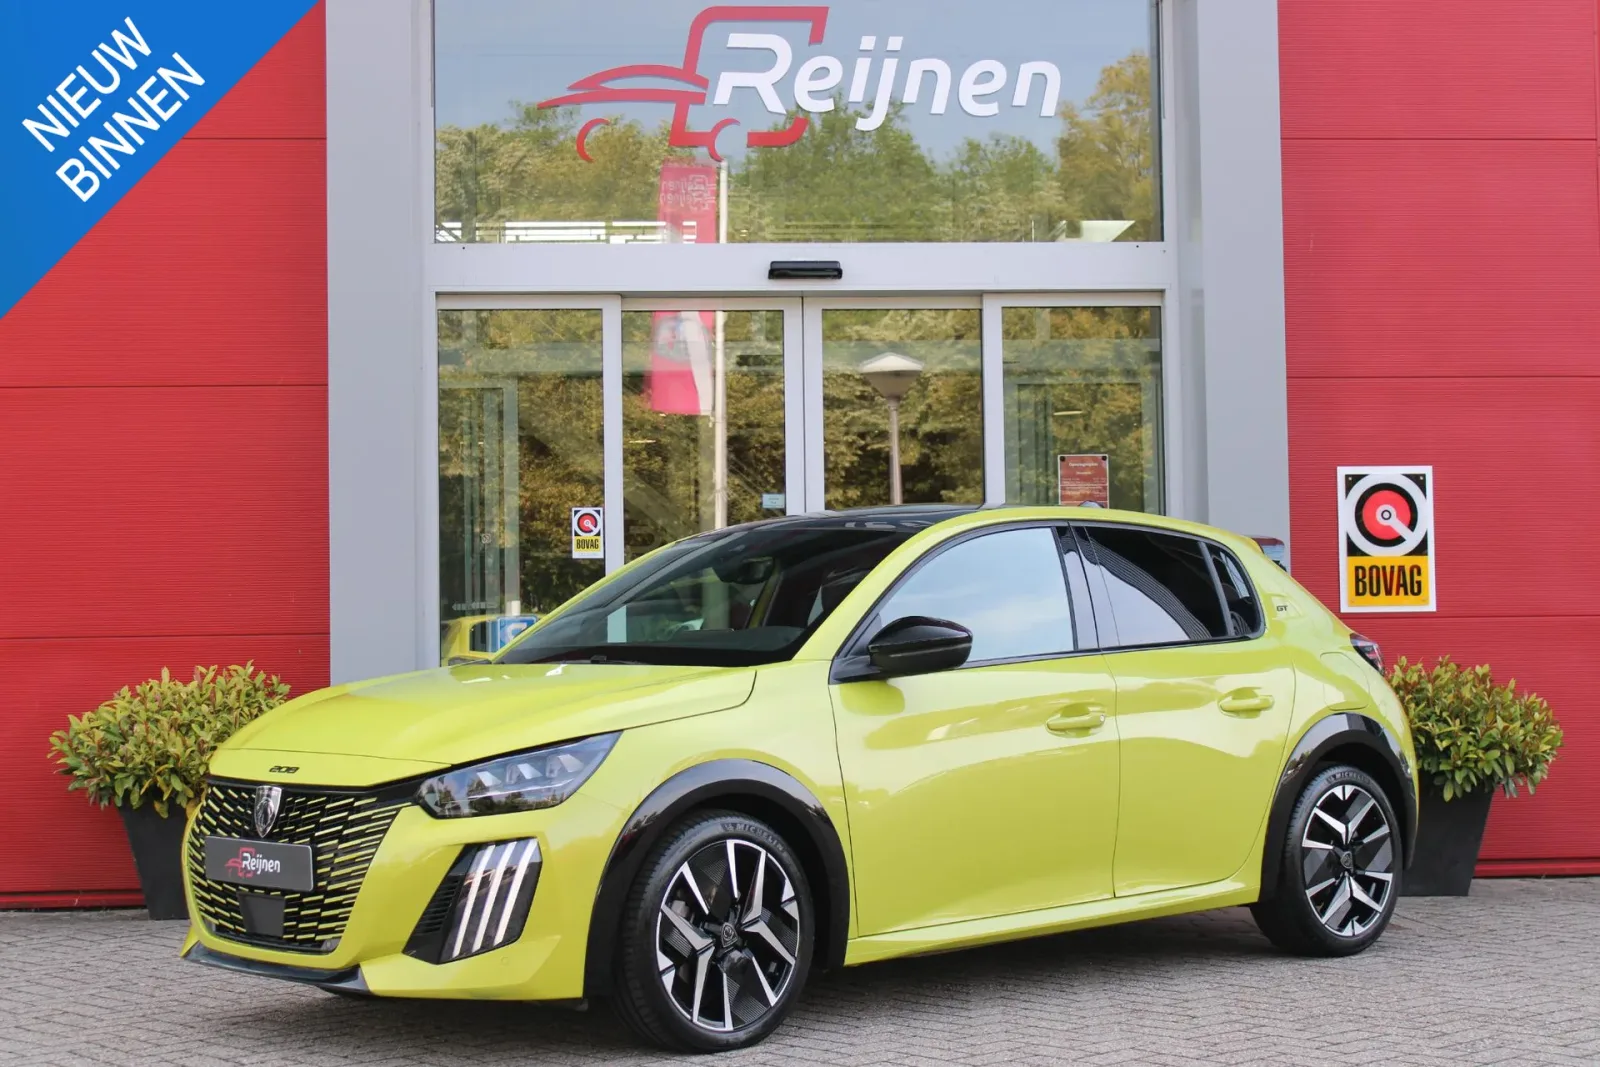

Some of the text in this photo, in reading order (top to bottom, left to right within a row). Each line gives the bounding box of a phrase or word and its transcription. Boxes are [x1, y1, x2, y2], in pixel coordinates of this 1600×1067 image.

[713, 33, 1062, 132] Reijnen
[576, 538, 599, 550] BOVAG
[1354, 564, 1422, 597] BOVAG
[269, 765, 300, 774] 208
[736, 823, 785, 852] MICHELIN
[241, 852, 281, 875] Reijnen
